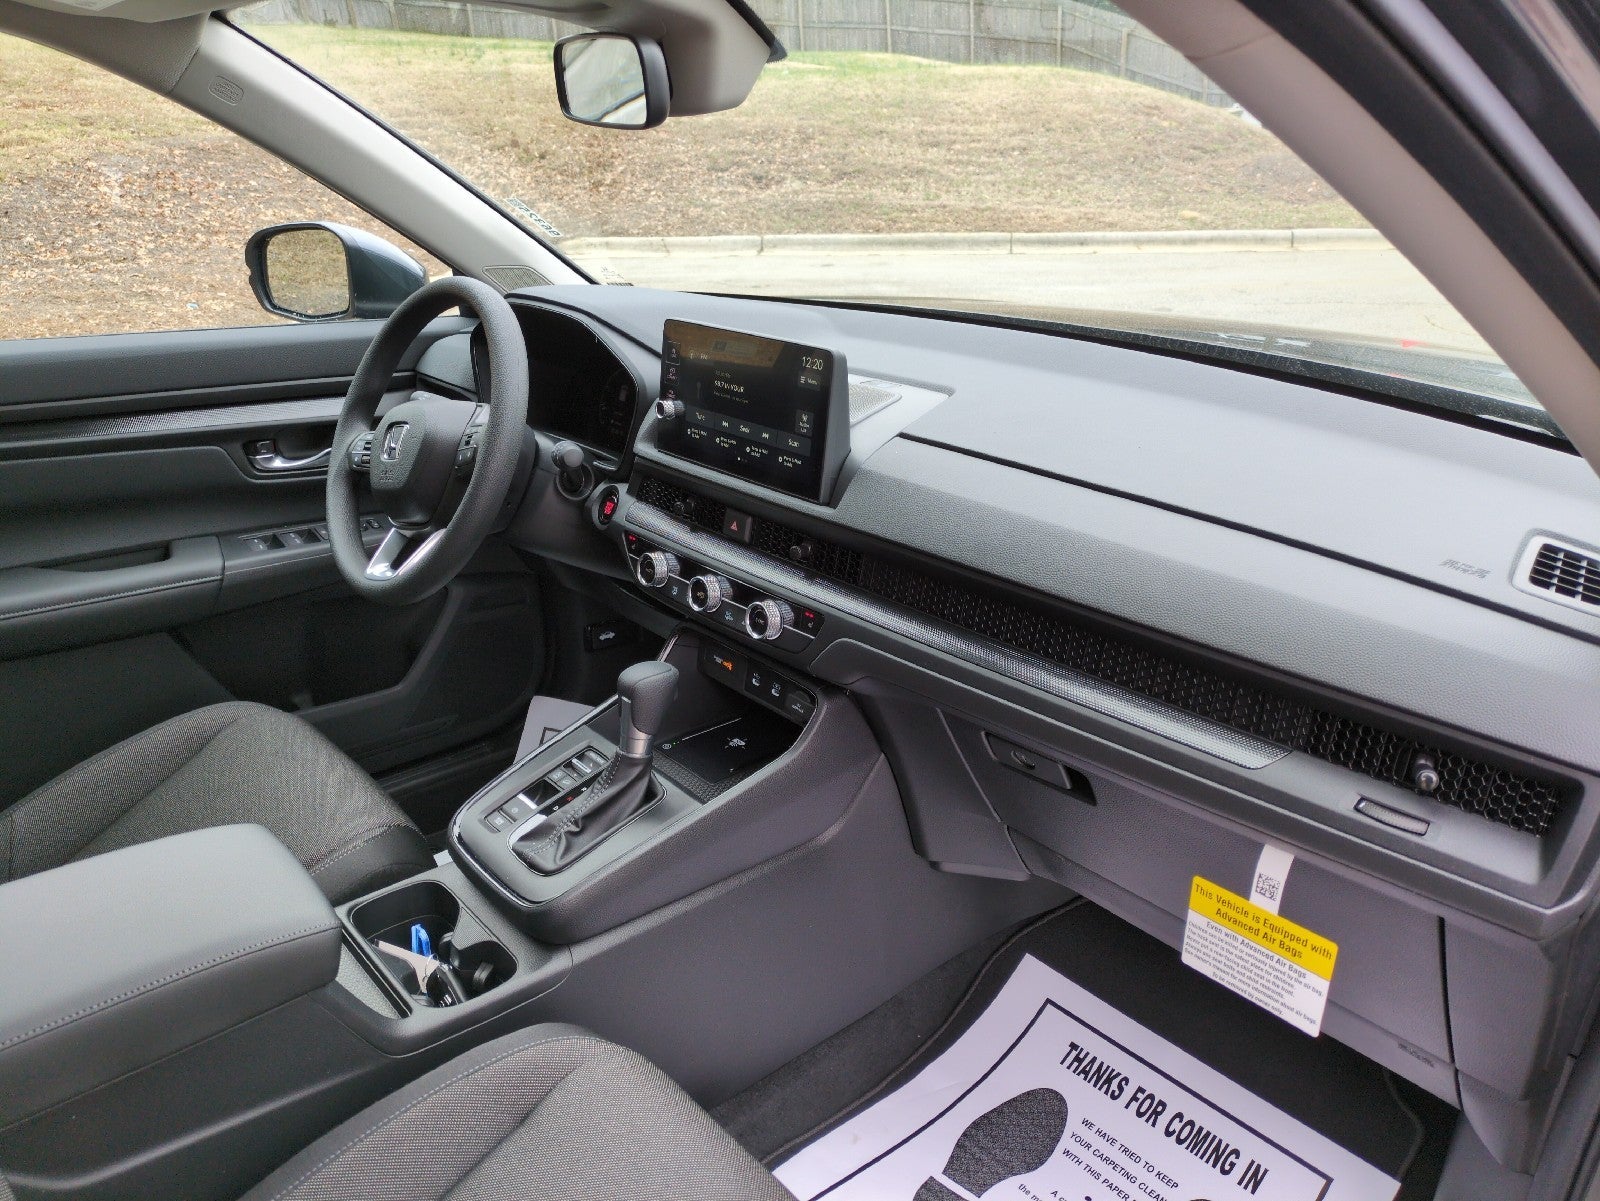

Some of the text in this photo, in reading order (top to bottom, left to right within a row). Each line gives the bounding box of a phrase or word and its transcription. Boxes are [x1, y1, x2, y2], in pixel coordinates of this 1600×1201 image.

[802, 356, 823, 370] 12:20
[1195, 883, 1333, 960] This Vehicle is Equipped with
[1215, 907, 1303, 960] Advanced Air Bags
[1206, 920, 1306, 980] Even with Advanced Air Bags
[1059, 1041, 1269, 1195] THANKS FOR COMING IN
[1062, 1148, 1130, 1201] WITH THIS PAPER
[1070, 1131, 1093, 1151] YOUR
[1092, 1148, 1137, 1184] CARPETING
[1081, 1117, 1179, 1190] WE HAVE TRIED TO KEEP
[1018, 1183, 1031, 1197] the
[1050, 1190, 1058, 1198] A
